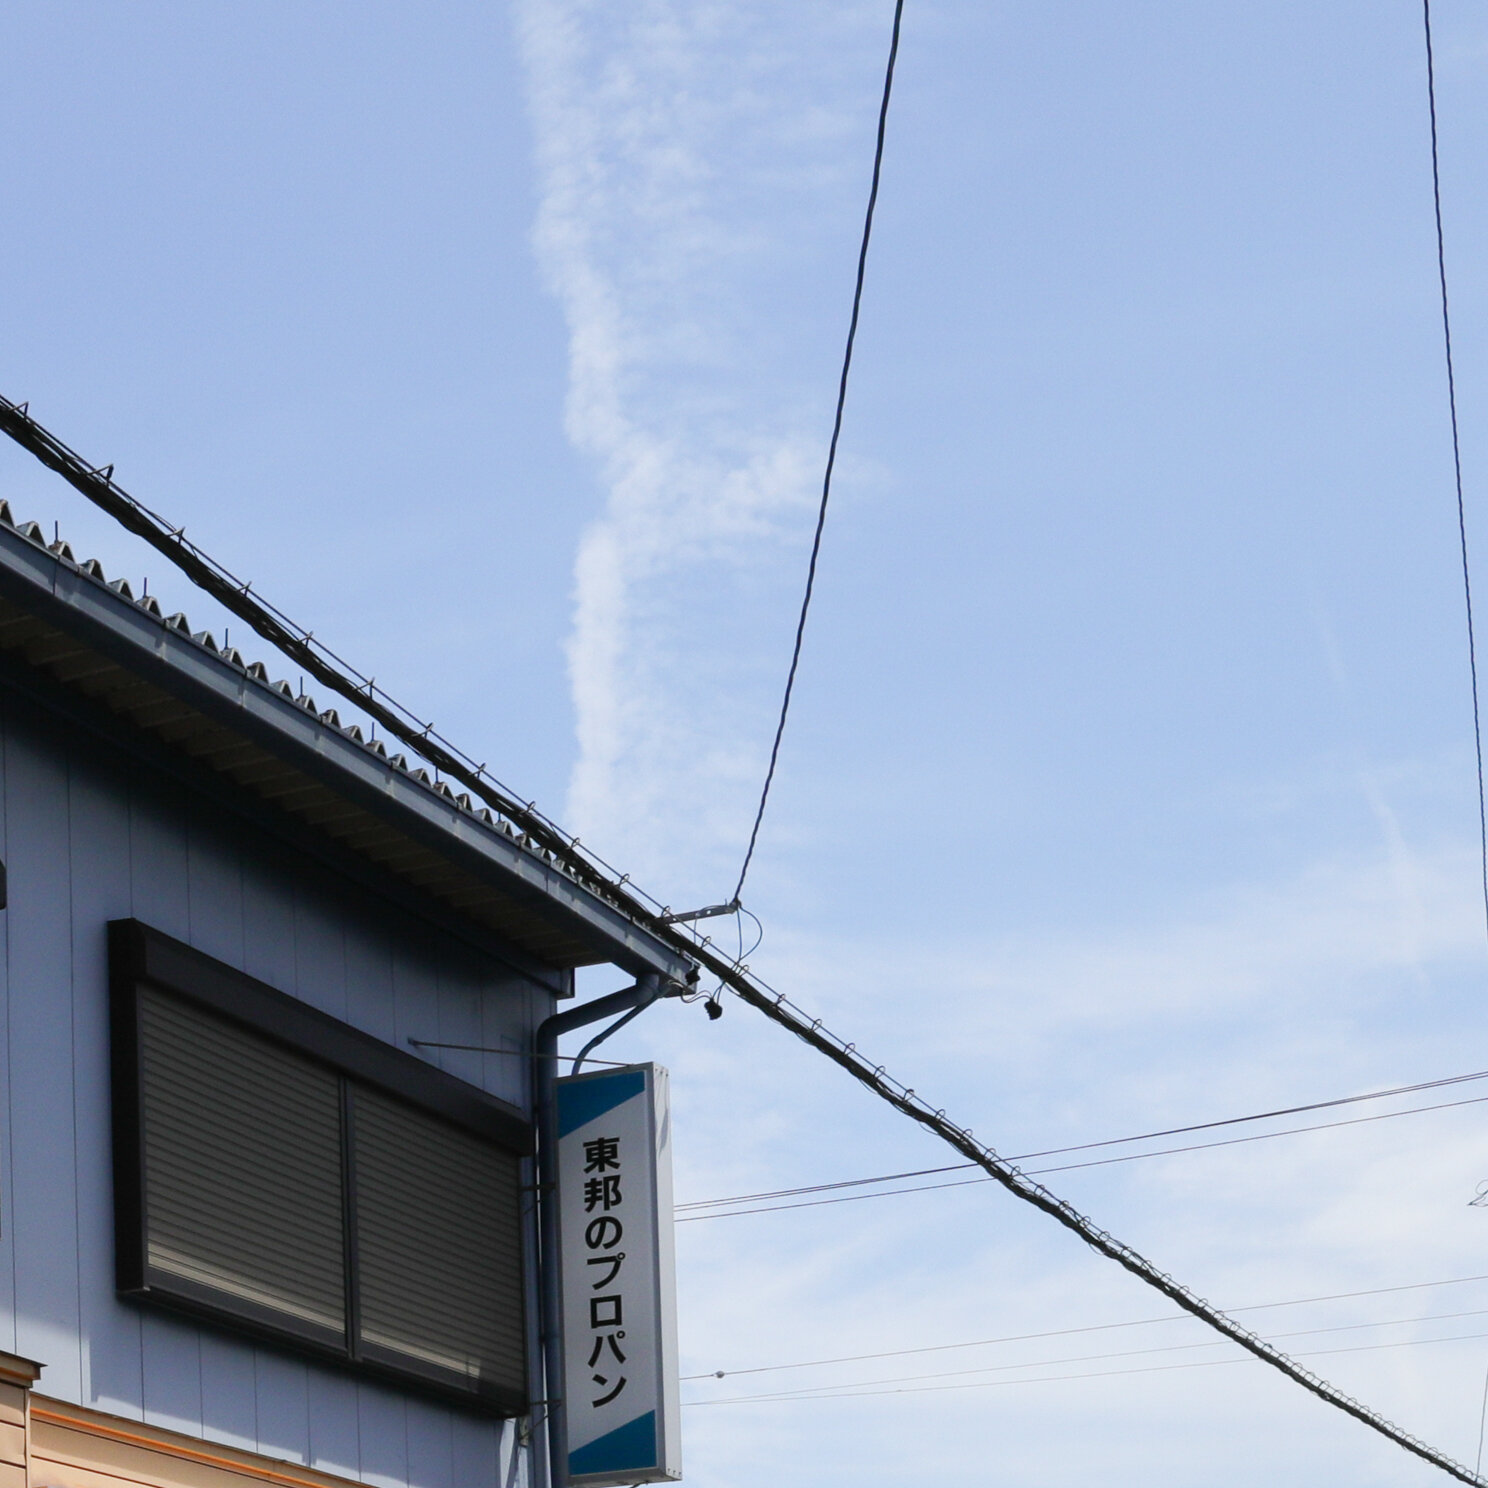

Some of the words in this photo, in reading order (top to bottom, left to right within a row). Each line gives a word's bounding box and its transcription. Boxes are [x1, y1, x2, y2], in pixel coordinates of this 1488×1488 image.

[582, 1136, 627, 1409] 東邦のプロパン
